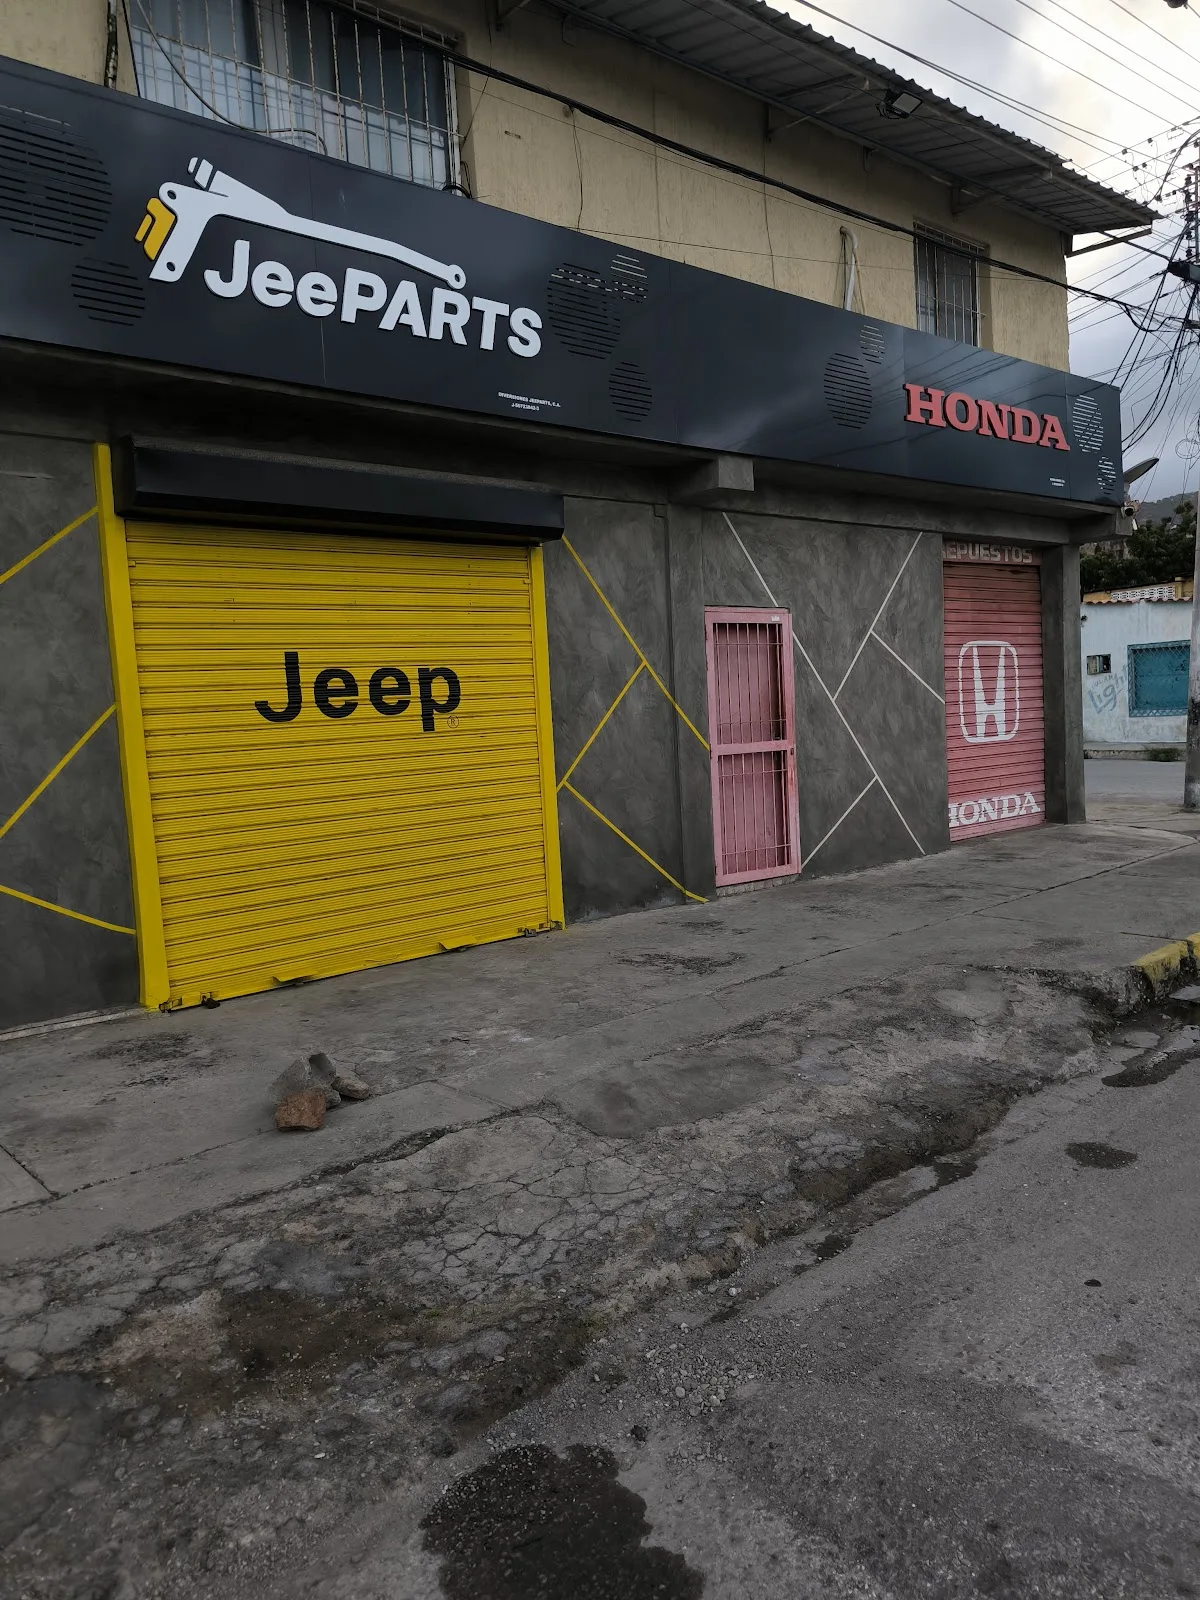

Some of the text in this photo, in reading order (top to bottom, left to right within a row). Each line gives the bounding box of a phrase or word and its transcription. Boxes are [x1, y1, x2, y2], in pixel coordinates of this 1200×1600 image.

[203, 239, 543, 358] JeePARTS
[904, 383, 1071, 451] HONDA
[254, 651, 461, 732] Jeep
